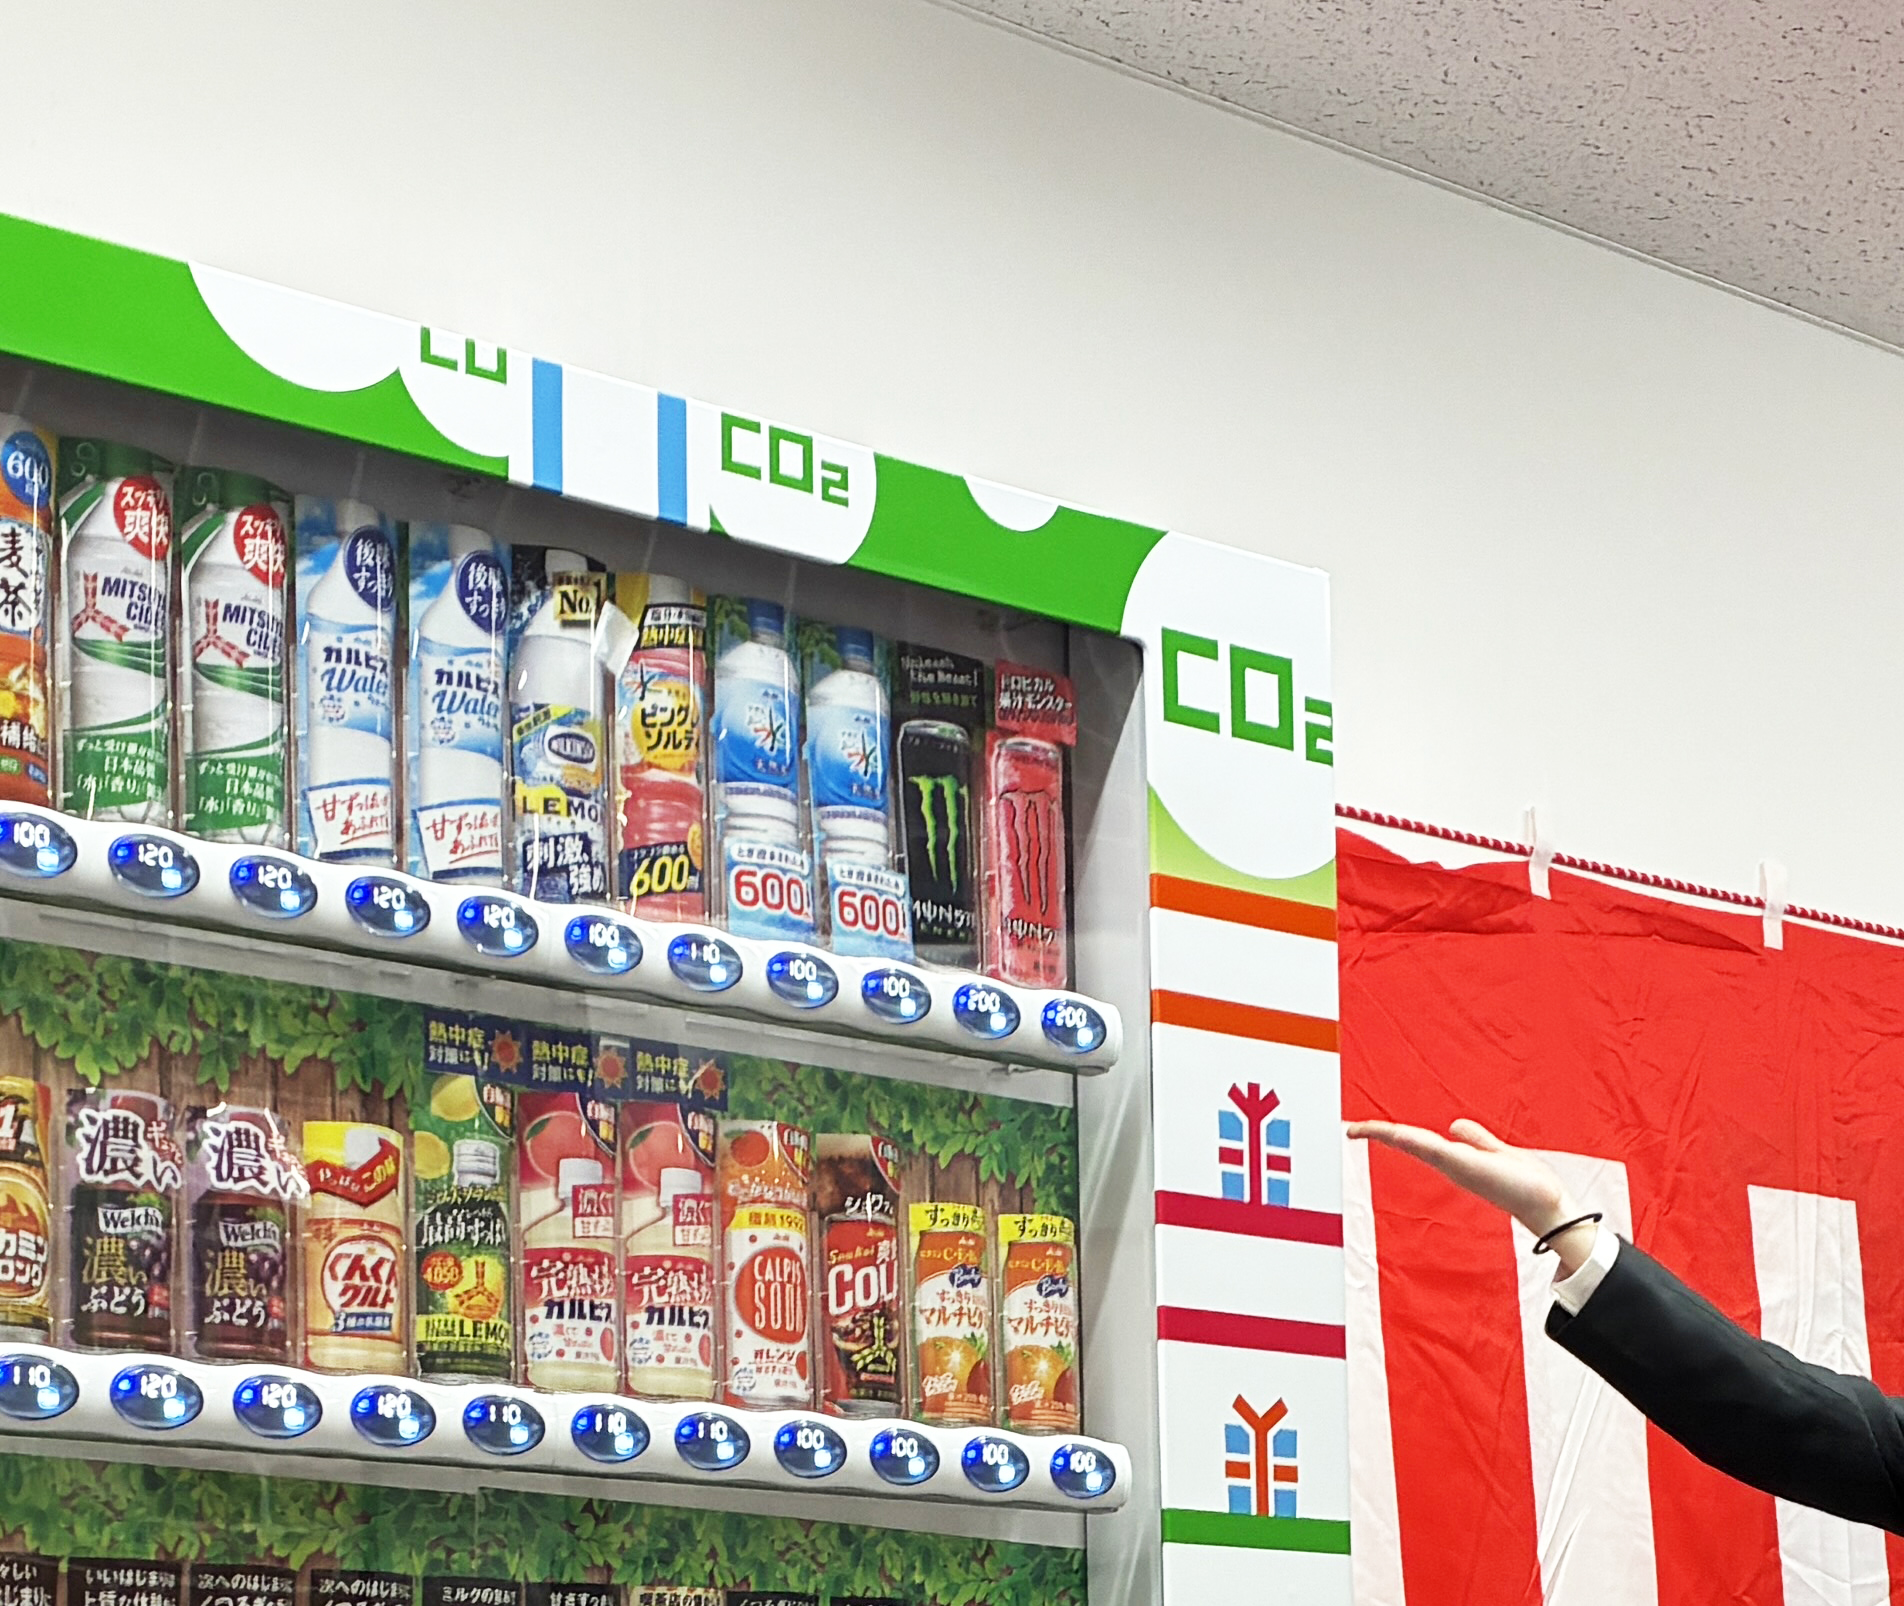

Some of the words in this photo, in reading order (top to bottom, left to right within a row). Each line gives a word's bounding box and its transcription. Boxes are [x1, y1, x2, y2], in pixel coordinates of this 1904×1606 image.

[6, 453, 49, 488] 600
[721, 411, 849, 507] CO2
[123, 508, 169, 545] 爽快
[243, 536, 286, 574] 爽快
[13, 822, 50, 848] 100
[138, 843, 173, 868] 120
[258, 864, 291, 889] 120
[629, 853, 689, 897] 600
[373, 886, 406, 910] 120
[589, 922, 619, 948] 100
[690, 942, 720, 964] 110
[789, 959, 816, 982] 100
[882, 976, 910, 998] 100
[78, 1110, 182, 1192] 濃い
[204, 1121, 311, 1199] 濃い
[82, 1236, 148, 1285] 濃い
[204, 1248, 268, 1298] 濃い
[80, 1285, 147, 1316] ぶどう
[203, 1297, 266, 1328] ぶどう
[12, 1364, 51, 1389] 110
[140, 1373, 177, 1399] 120
[261, 1383, 297, 1409] 120
[377, 1393, 412, 1418] 120
[489, 1404, 521, 1426] 110
[595, 1412, 627, 1436] 110
[697, 1420, 728, 1442] 110
[796, 1430, 825, 1450] 100
[891, 1438, 918, 1458] 100
[982, 1443, 1009, 1466] 100
[1070, 1450, 1097, 1473] 100
